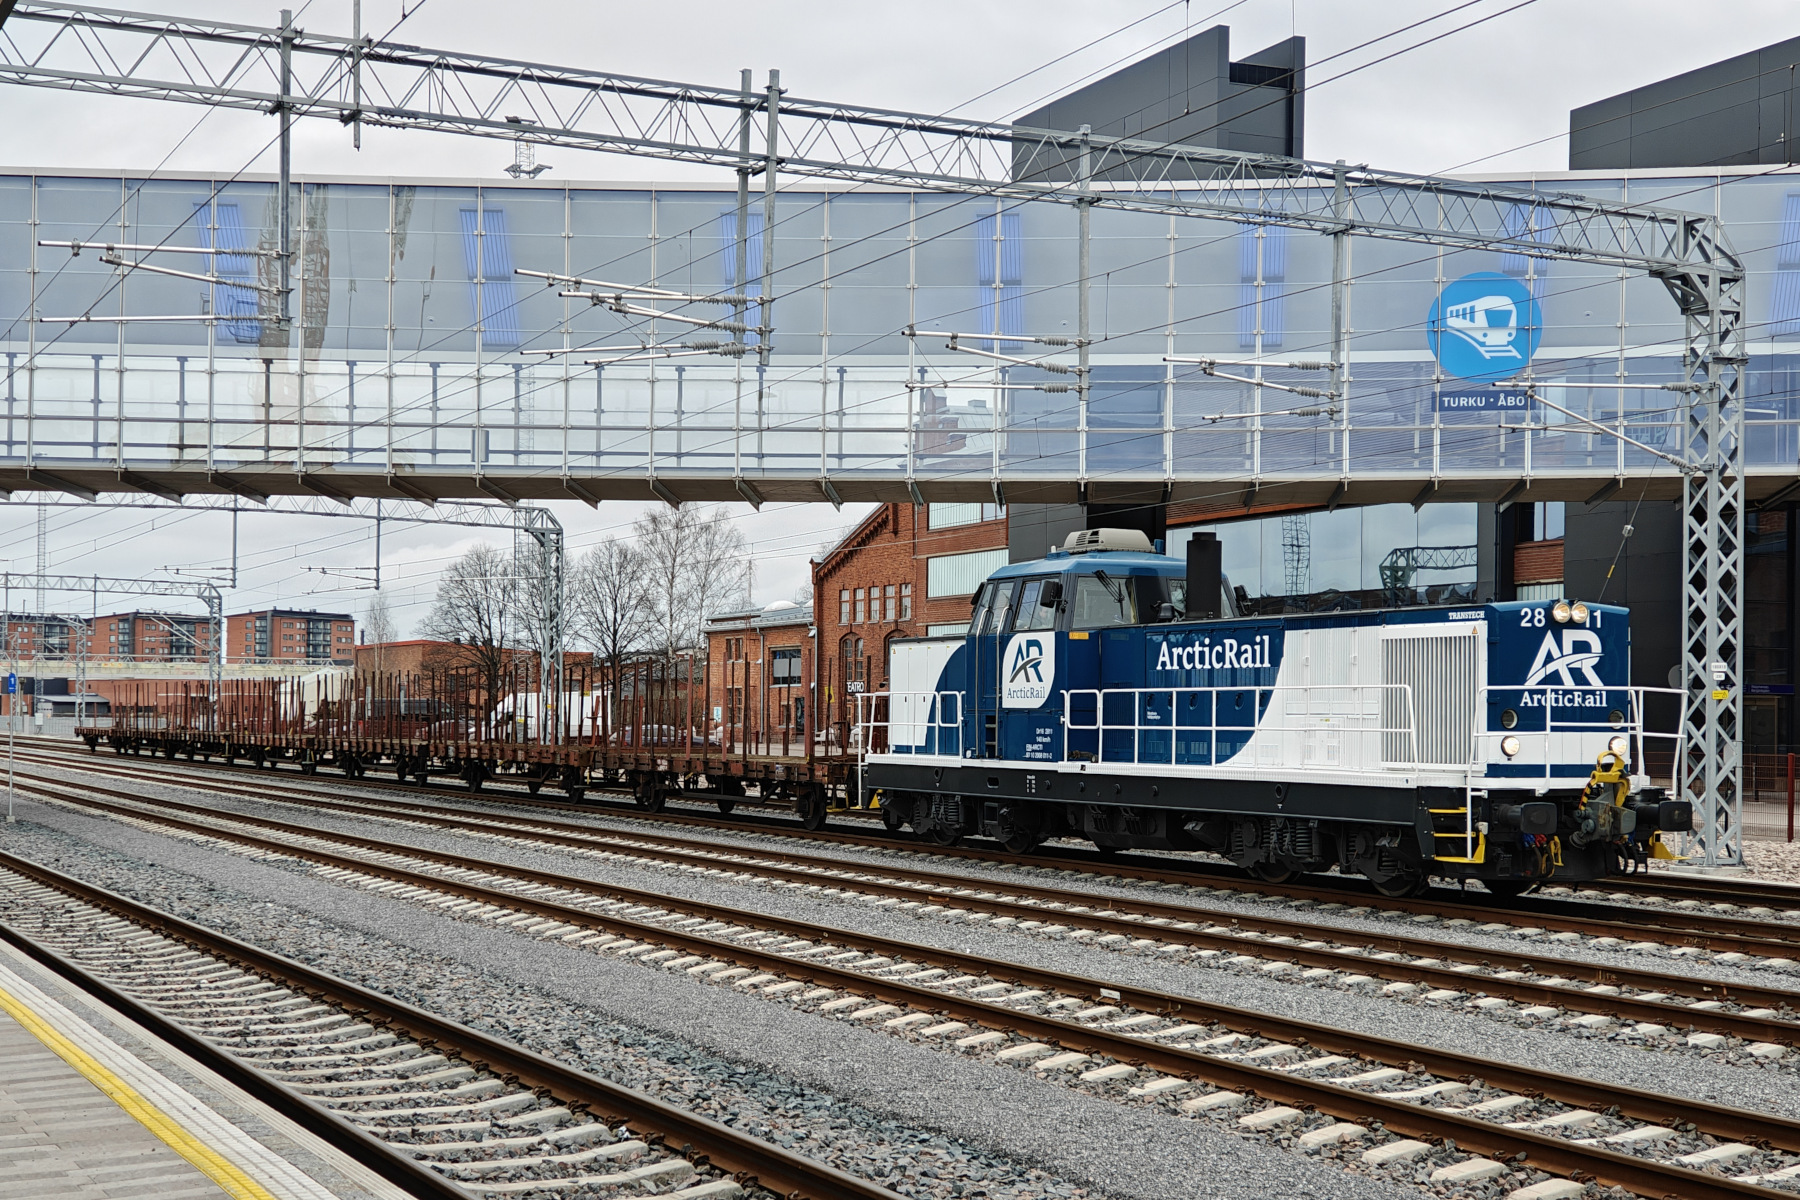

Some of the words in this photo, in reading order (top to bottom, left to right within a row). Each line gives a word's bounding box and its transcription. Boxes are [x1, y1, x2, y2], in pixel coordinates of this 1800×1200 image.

[1442, 396, 1486, 408] TURKU
[1497, 392, 1526, 407] ÅBO
[1448, 610, 1486, 620] TRANSTECH
[1520, 607, 1546, 628] 28
[1156, 635, 1272, 671] ArcticRail
[1007, 686, 1046, 699] ArcticRail
[1519, 690, 1608, 708] ArcticRail
